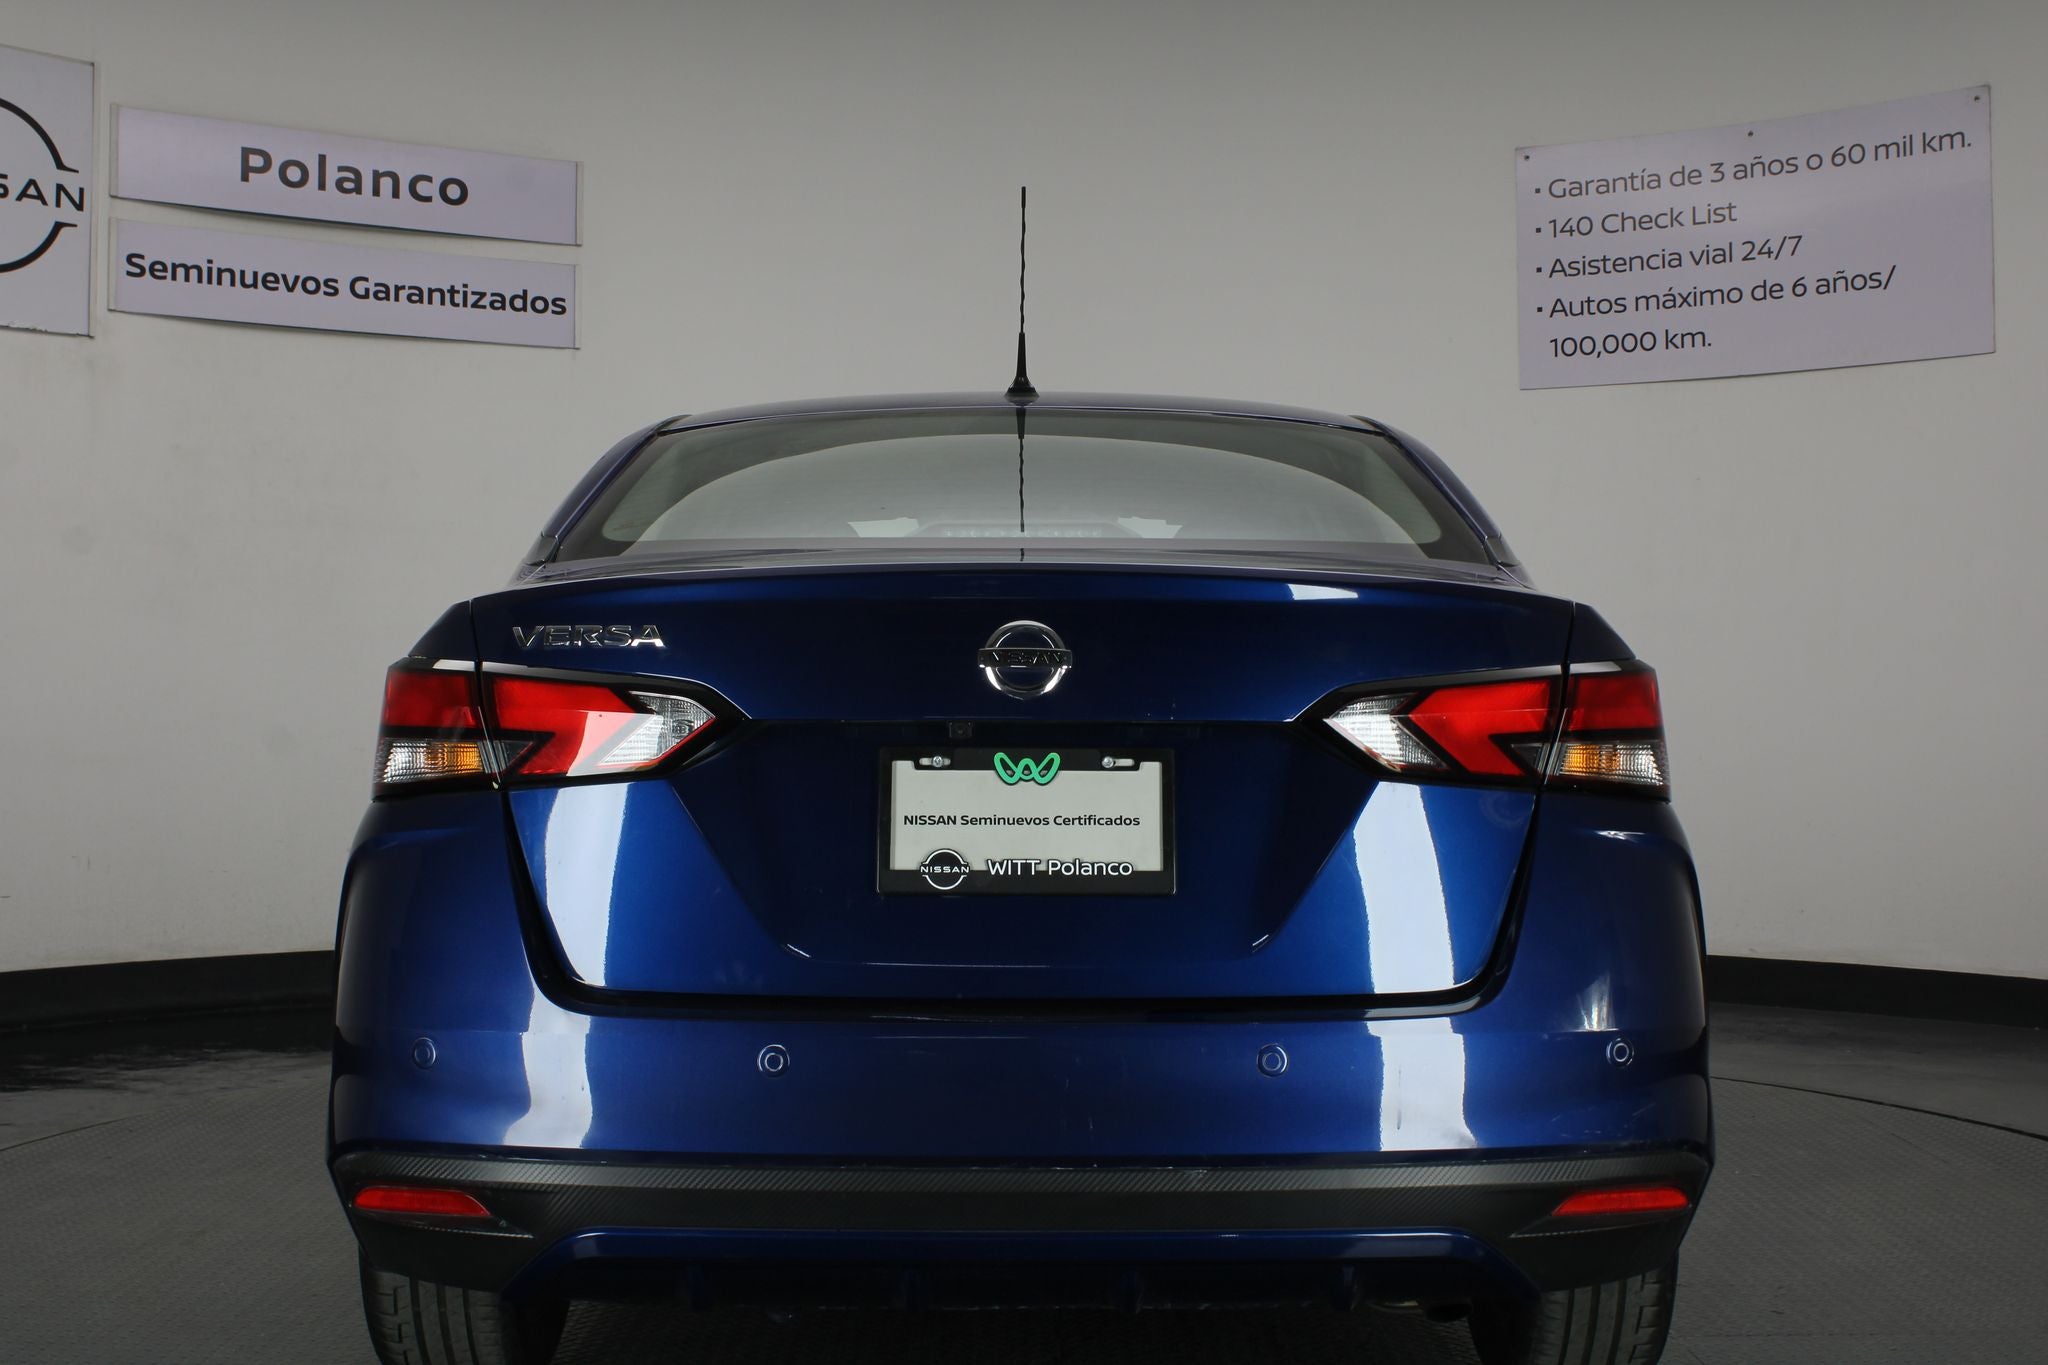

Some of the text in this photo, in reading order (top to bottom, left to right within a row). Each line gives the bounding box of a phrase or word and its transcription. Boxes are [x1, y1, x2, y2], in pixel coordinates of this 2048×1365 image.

[240, 146, 469, 206] Polanco
[1547, 128, 1972, 200] Garantía de 3 años o 60 mil km.
[1549, 202, 1738, 239] 140 Check List
[1549, 235, 1803, 278] Asistencia vial 24/7
[125, 253, 567, 316] Seminuevos Garantizados
[1549, 264, 1897, 319] Autos máximo de 6 años/
[1549, 328, 1713, 360] 100,000 km.
[512, 624, 665, 648] VERSA
[903, 814, 1141, 827] NISSAN Seminuevos Certificados
[920, 864, 970, 874] NISSAN
[987, 859, 1133, 876] WITT Polanco
